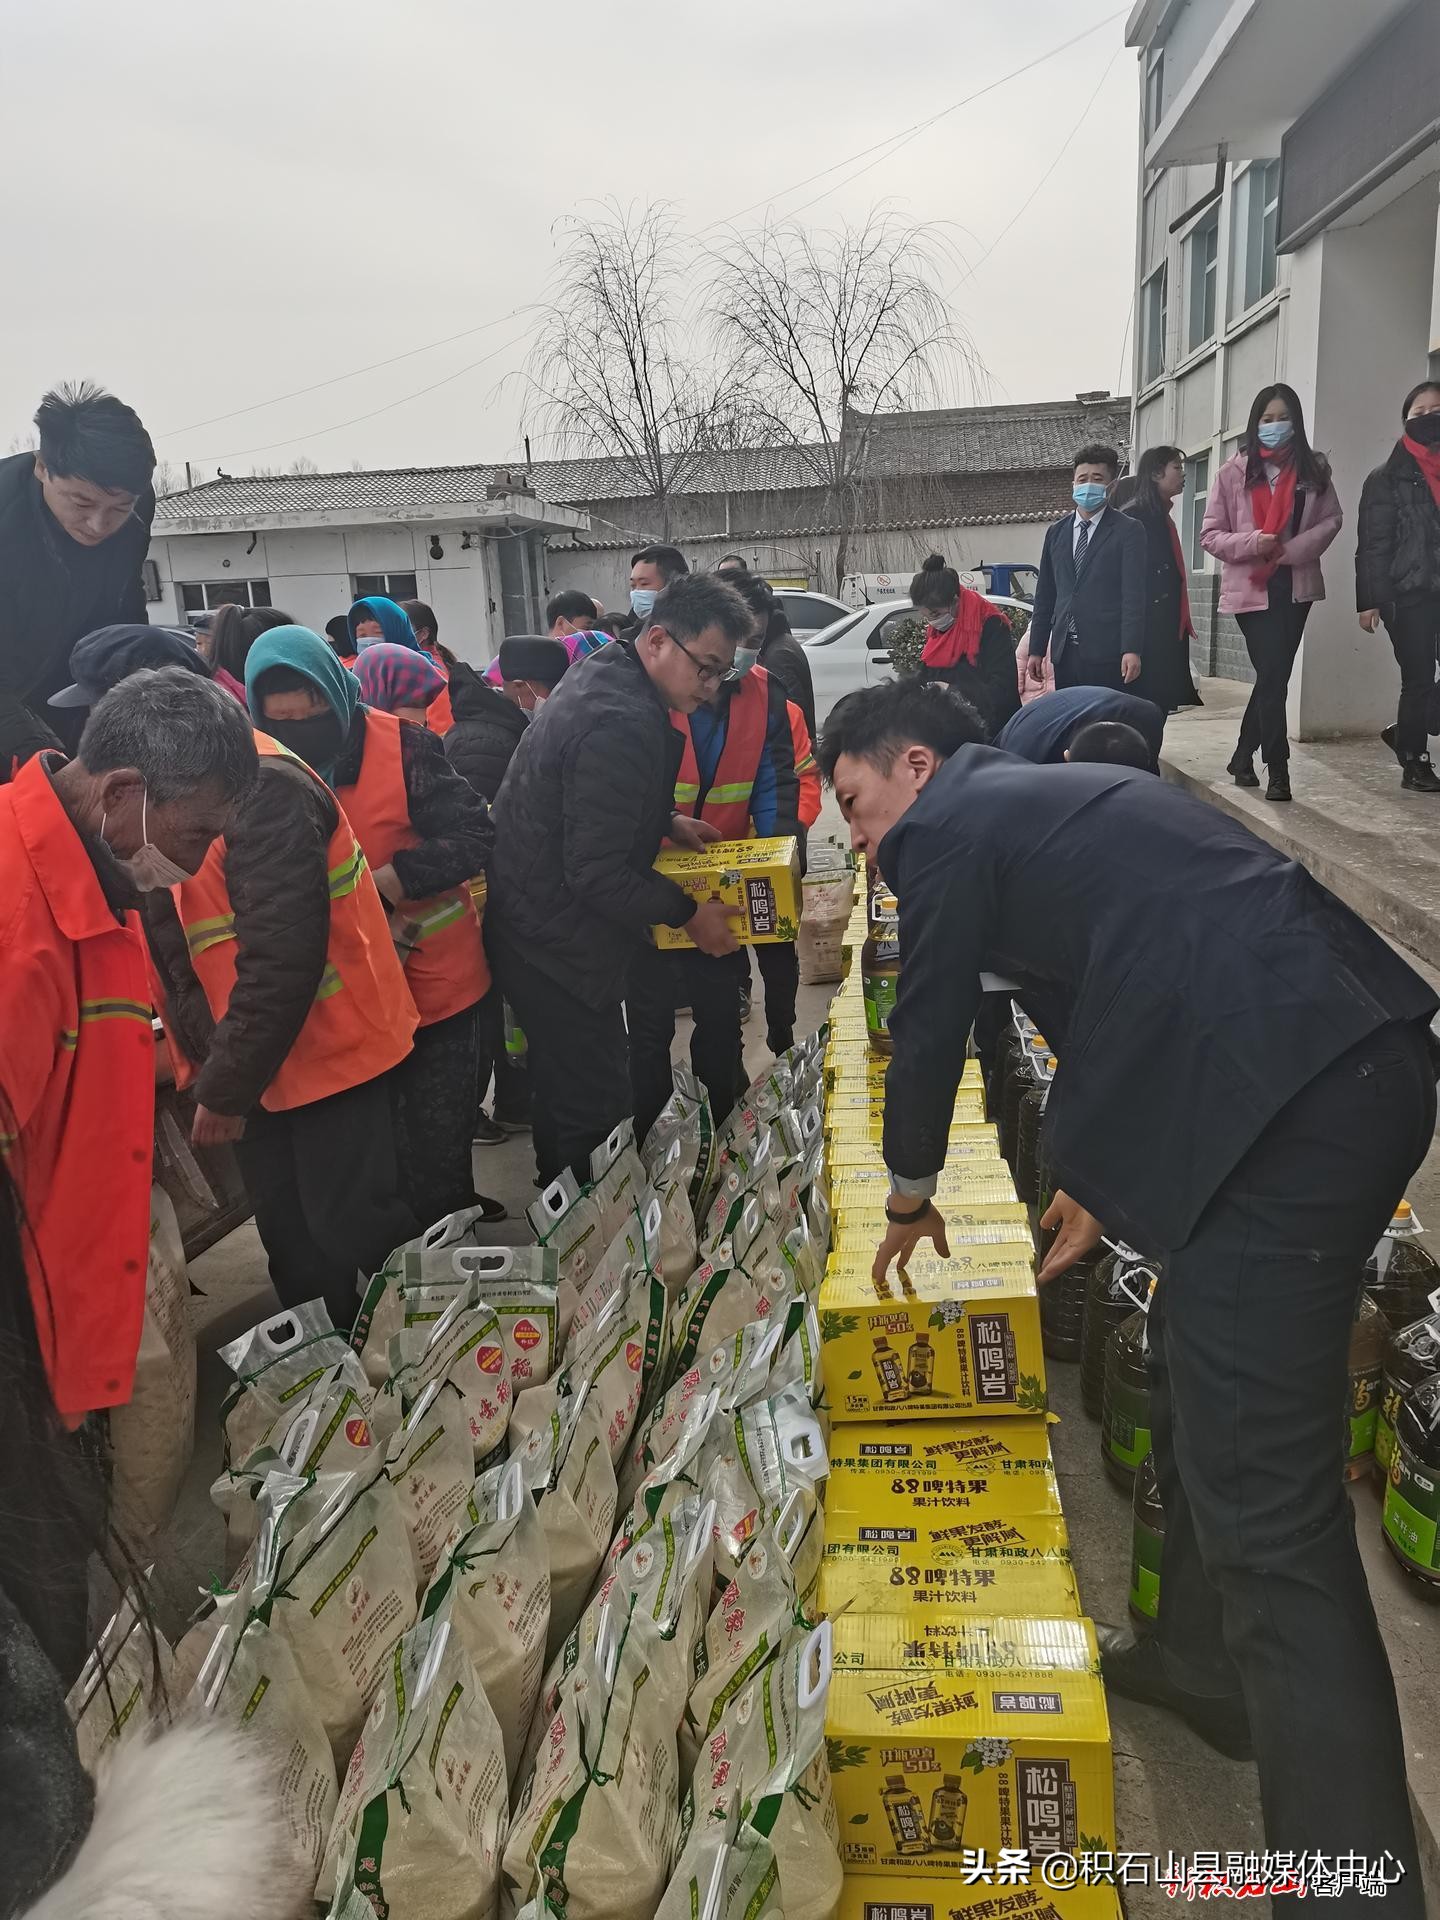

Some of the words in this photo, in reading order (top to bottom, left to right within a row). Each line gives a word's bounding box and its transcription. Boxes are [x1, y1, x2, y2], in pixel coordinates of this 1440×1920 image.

[750, 881, 770, 933] 松鸣岩
[976, 1320, 1007, 1397] 松鸣岩
[863, 1445, 908, 1455] 松鸣岩
[923, 1434, 993, 1457] 鲜果发酵
[951, 1441, 1012, 1463] 更解腻
[830, 1458, 937, 1470] 特果集团有限公司
[891, 1478, 990, 1495] 88啤特果
[912, 1496, 971, 1508] 果汁饮料
[864, 1529, 912, 1540] 松鸣岩
[930, 1519, 1007, 1543] 鲜果发酵
[959, 1527, 1025, 1552] 更解腻
[823, 1543, 899, 1556] 团有限公司
[888, 1566, 999, 1586] 88啤特果
[912, 1589, 978, 1603] 果汁饮料
[923, 1624, 990, 1638] 汁饮料
[833, 1652, 865, 1666] 公司
[886, 1690, 980, 1727] 鲜果发酵
[999, 1694, 1057, 1711] 松鸣岩
[904, 1759, 941, 1774] 50%
[1025, 1766, 1061, 1858] 松鸣岩
[897, 1805, 917, 1840] 松鸣岩
[948, 1888, 1043, 1920] 鲜果发酵
